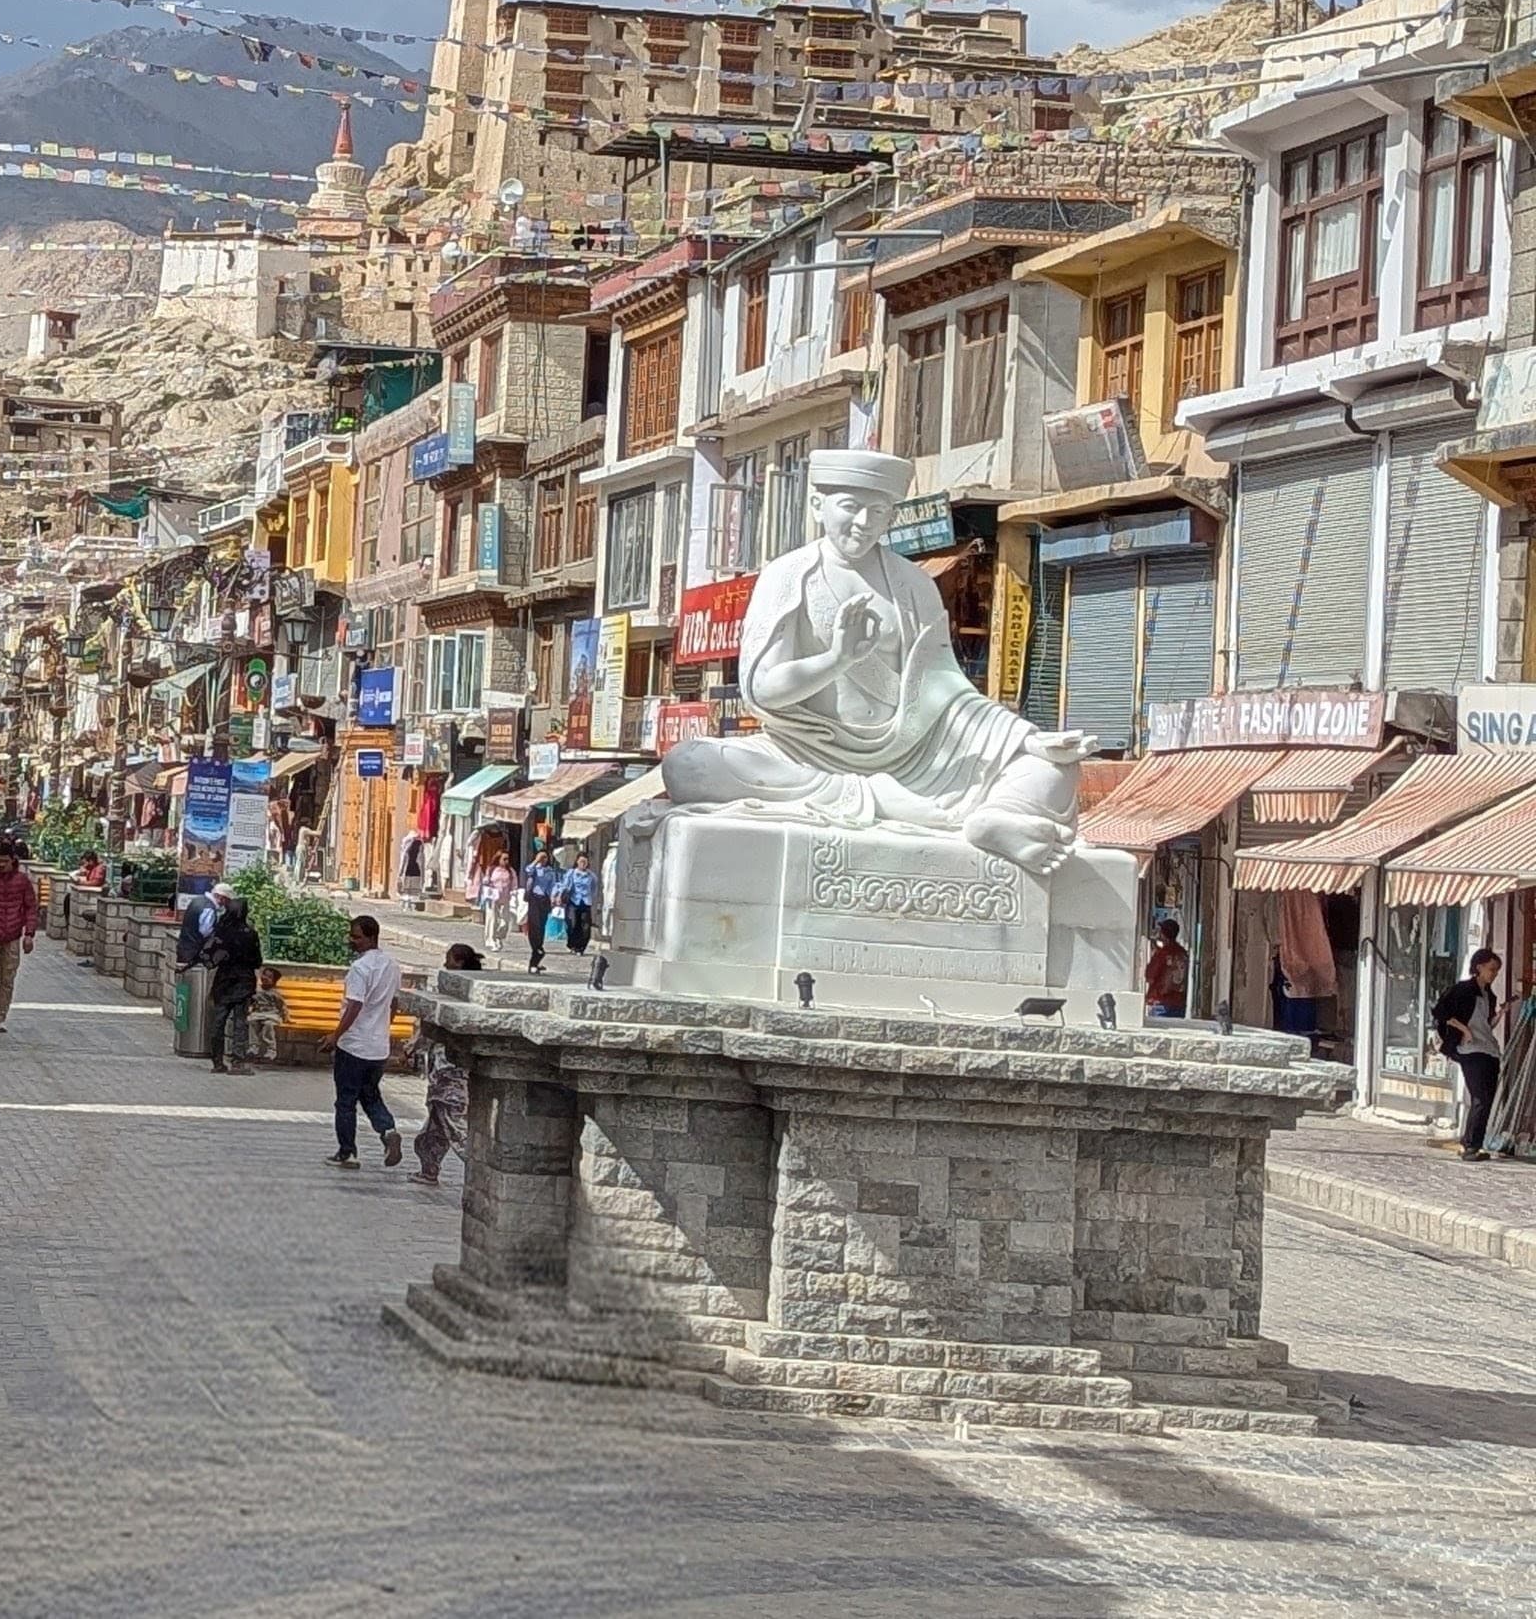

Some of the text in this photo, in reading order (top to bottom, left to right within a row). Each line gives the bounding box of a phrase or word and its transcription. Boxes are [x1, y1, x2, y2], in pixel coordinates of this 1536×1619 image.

[680, 609, 712, 657] KIDS
[1006, 594, 1024, 685] HANDICRAFT
[1317, 700, 1371, 736] ZONE
